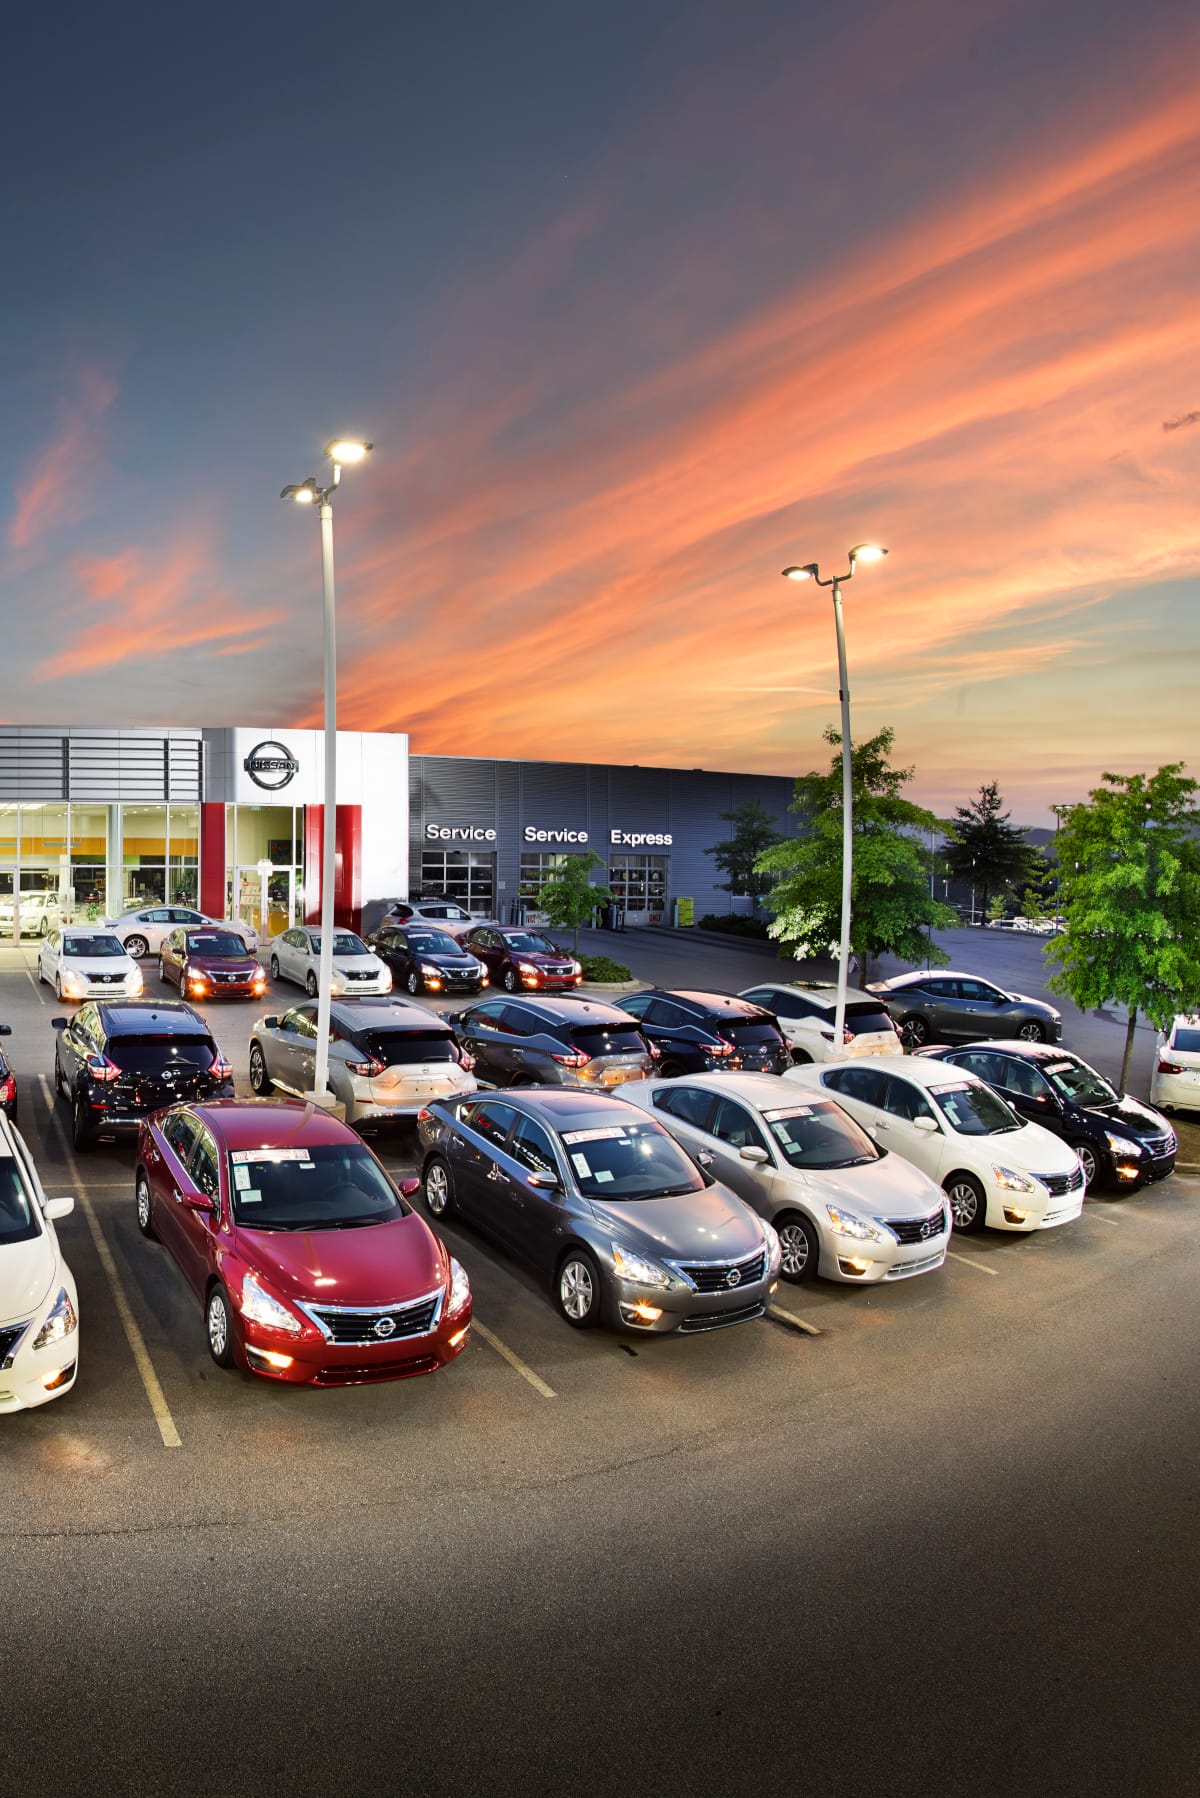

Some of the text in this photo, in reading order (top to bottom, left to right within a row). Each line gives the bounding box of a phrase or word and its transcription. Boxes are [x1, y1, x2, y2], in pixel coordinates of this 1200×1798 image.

[250, 760, 296, 771] NISSAN
[426, 824, 497, 841] Service
[524, 826, 589, 843] Service
[611, 829, 673, 847] Express
